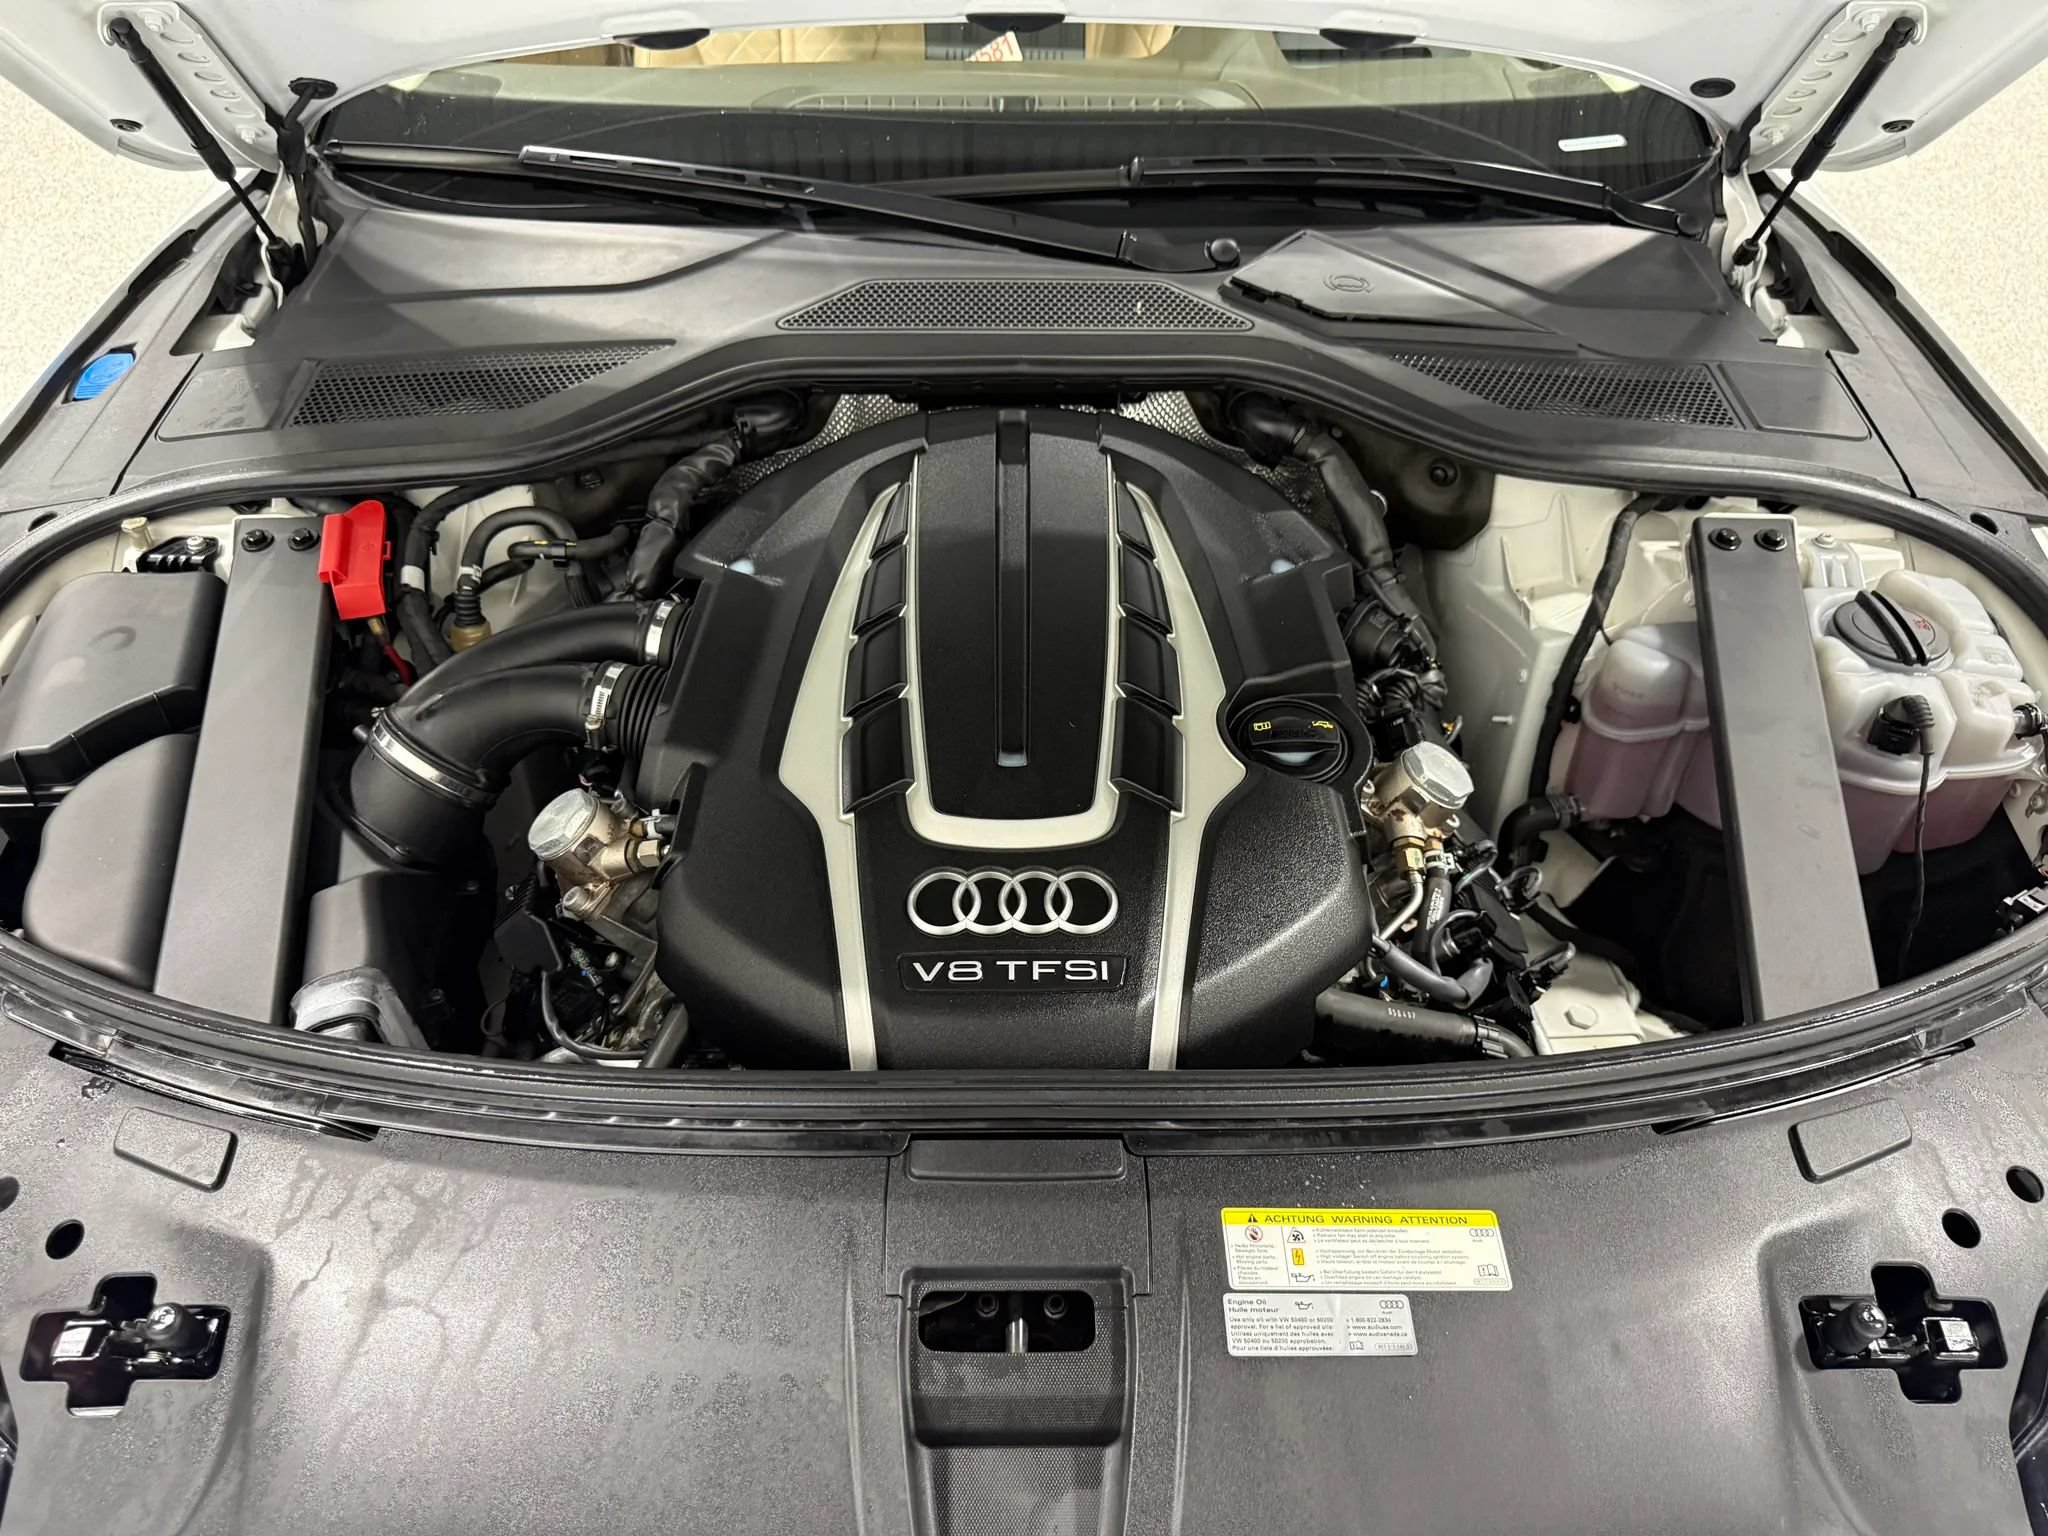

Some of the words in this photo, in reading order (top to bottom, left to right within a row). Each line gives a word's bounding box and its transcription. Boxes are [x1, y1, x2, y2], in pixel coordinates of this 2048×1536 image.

[912, 960, 983, 982] V8
[996, 960, 1108, 981] TFSI
[1264, 1215, 1324, 1223] ACHTUNG
[1331, 1216, 1392, 1224] WARNING
[1400, 1216, 1468, 1224] ATTENTION
